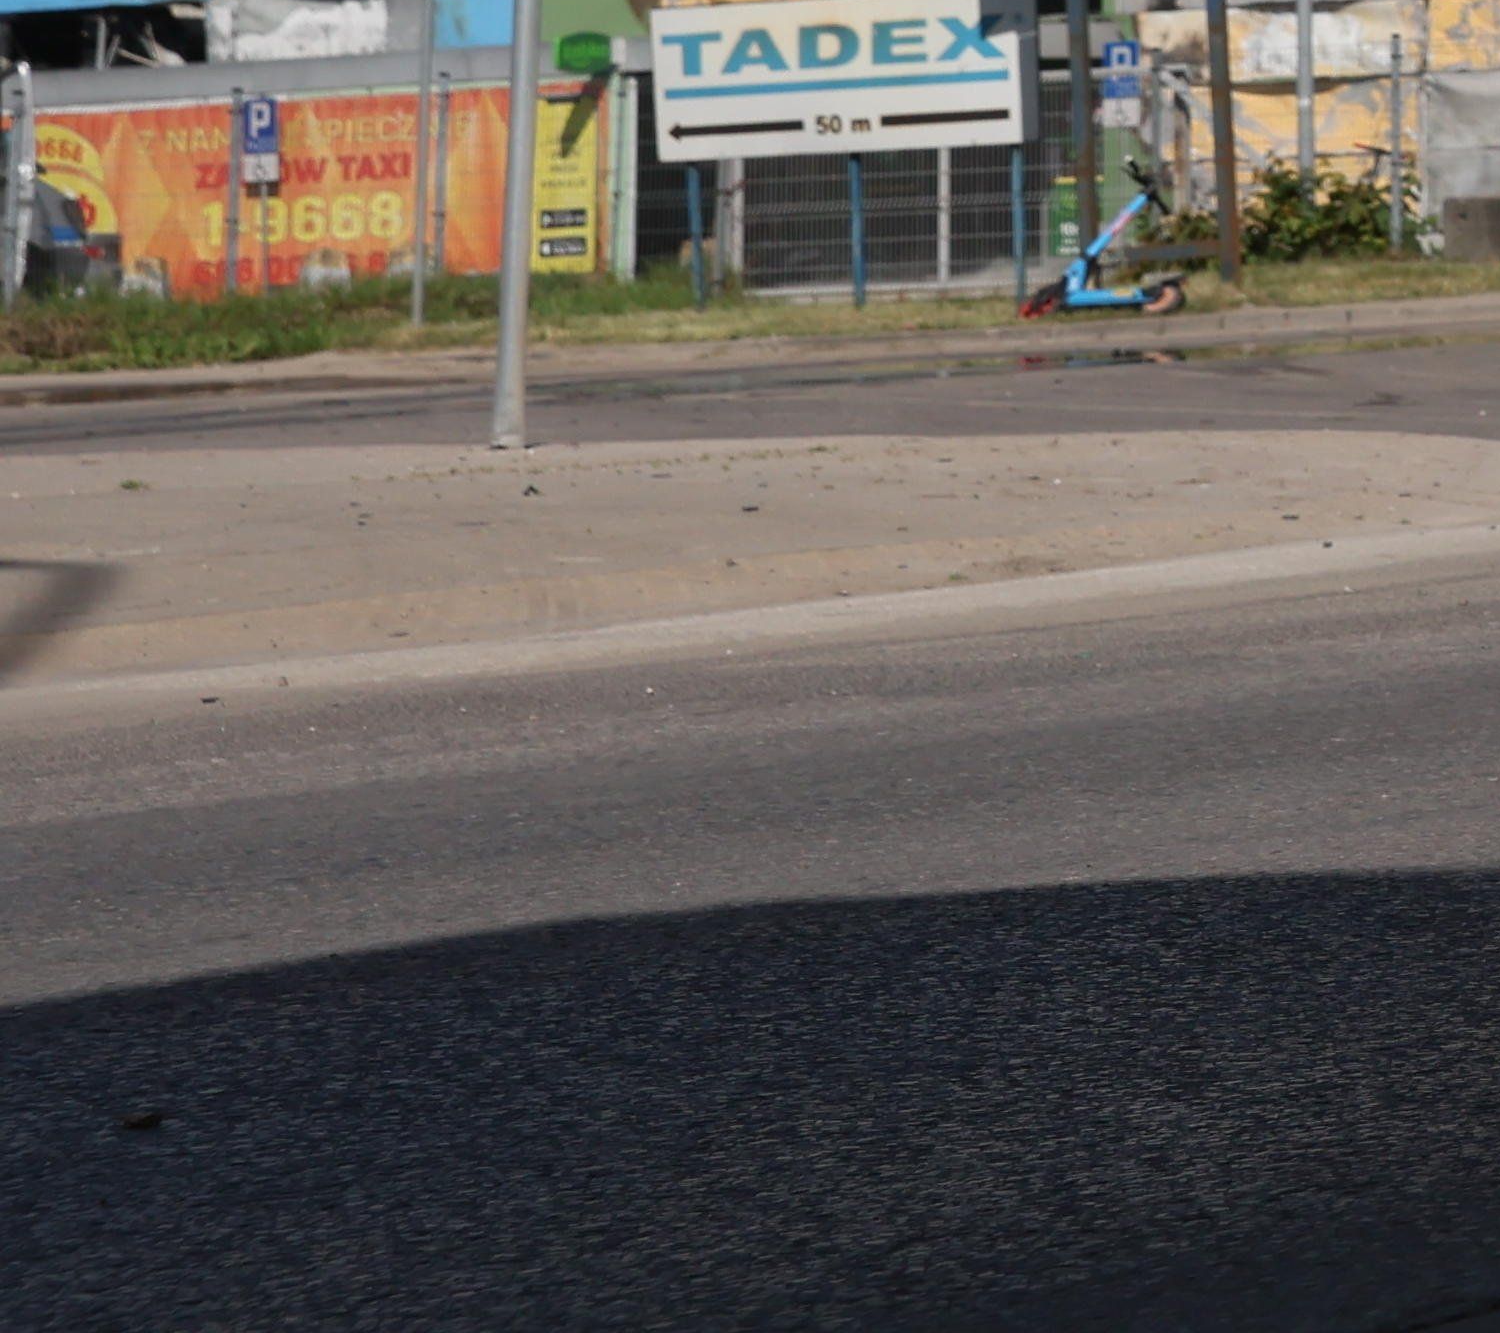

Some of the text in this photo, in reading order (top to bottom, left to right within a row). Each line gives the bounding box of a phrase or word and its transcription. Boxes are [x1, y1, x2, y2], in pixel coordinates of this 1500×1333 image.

[661, 14, 1005, 76] TADEX
[816, 117, 871, 134] 50 m
[338, 154, 412, 180] TAXI
